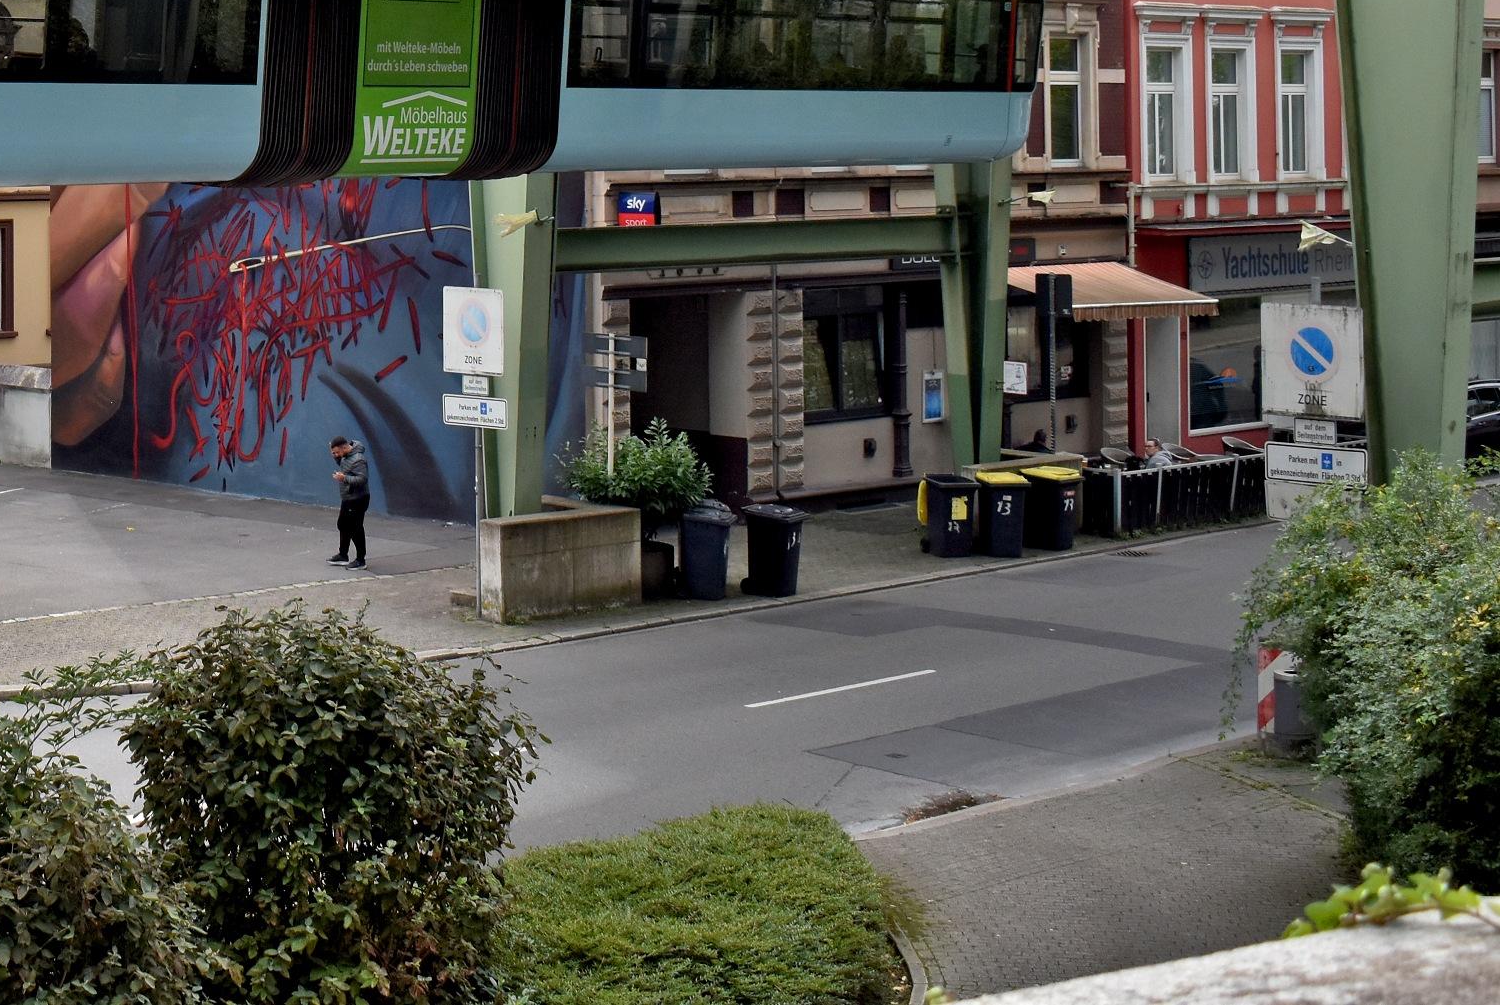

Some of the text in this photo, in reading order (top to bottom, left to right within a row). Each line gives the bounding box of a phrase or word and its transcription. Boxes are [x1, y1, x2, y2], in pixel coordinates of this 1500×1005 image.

[376, 41, 461, 54] mit Welteke-Möbeln
[400, 60, 426, 72] Leben
[427, 60, 468, 73] schweben
[400, 106, 467, 124] Möbelhaus
[626, 196, 646, 212] sky
[1222, 245, 1309, 279] Yachtschule
[464, 356, 483, 365] ZONE
[1298, 393, 1328, 406] ZONE
[458, 403, 472, 411] Parken
[1304, 423, 1327, 432] auf dem
[1288, 455, 1308, 463] Parken
[1309, 457, 1318, 465] mit
[1270, 468, 1319, 479] gekennzeichneten
[997, 501, 1012, 515] 13
